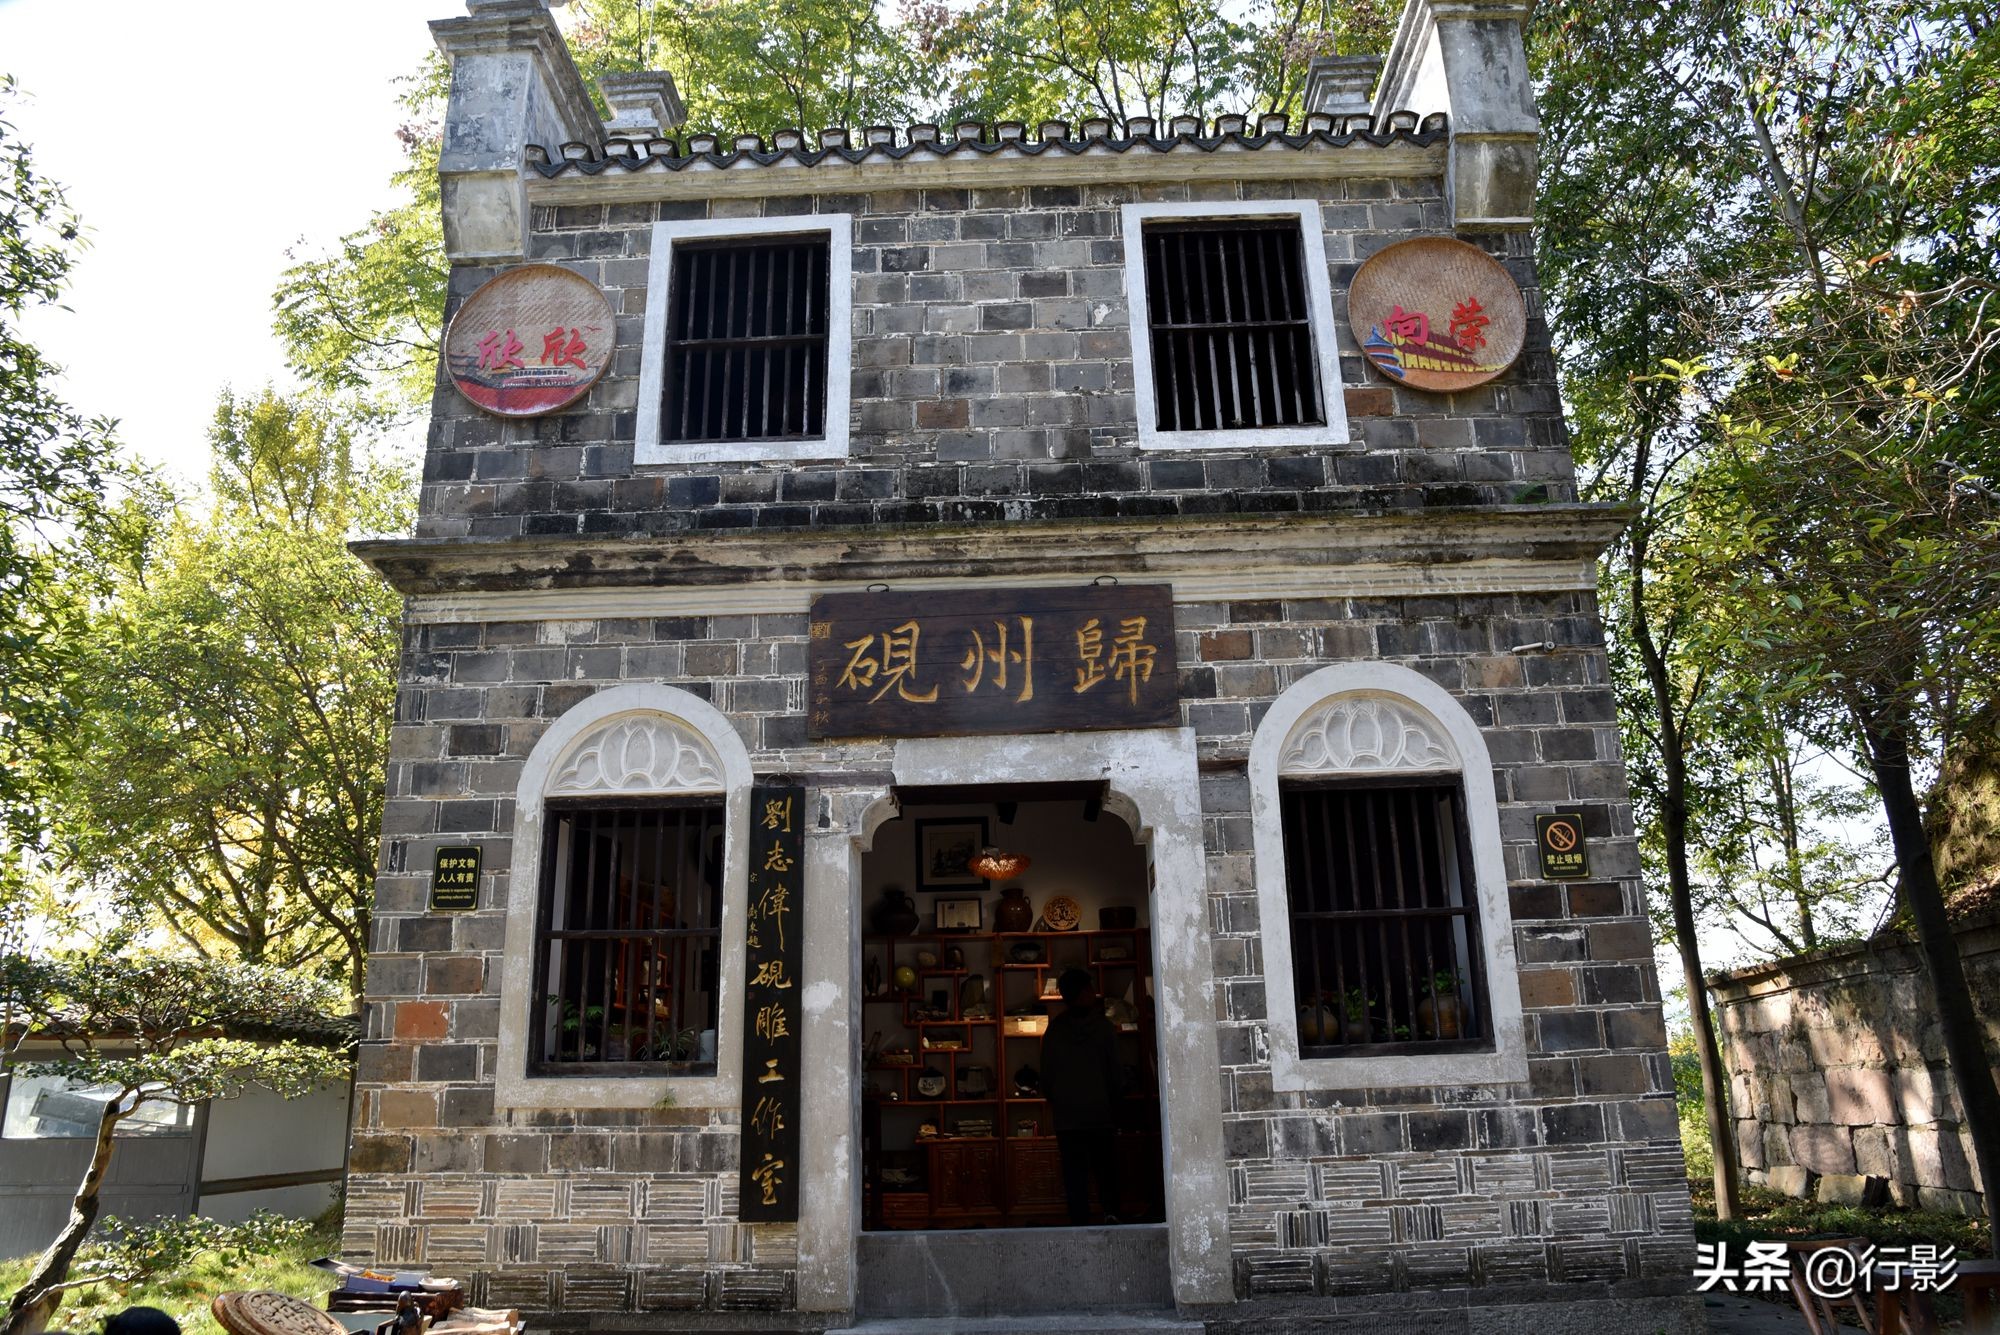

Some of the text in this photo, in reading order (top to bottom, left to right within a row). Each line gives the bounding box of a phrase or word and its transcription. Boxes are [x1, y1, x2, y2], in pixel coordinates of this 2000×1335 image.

[1382, 296, 1490, 349] 向荣
[475, 326, 587, 369] 欣欣
[440, 858, 476, 869] 保护文物
[1546, 853, 1583, 865] 禁止吸烟
[438, 872, 475, 883] 人人有责
